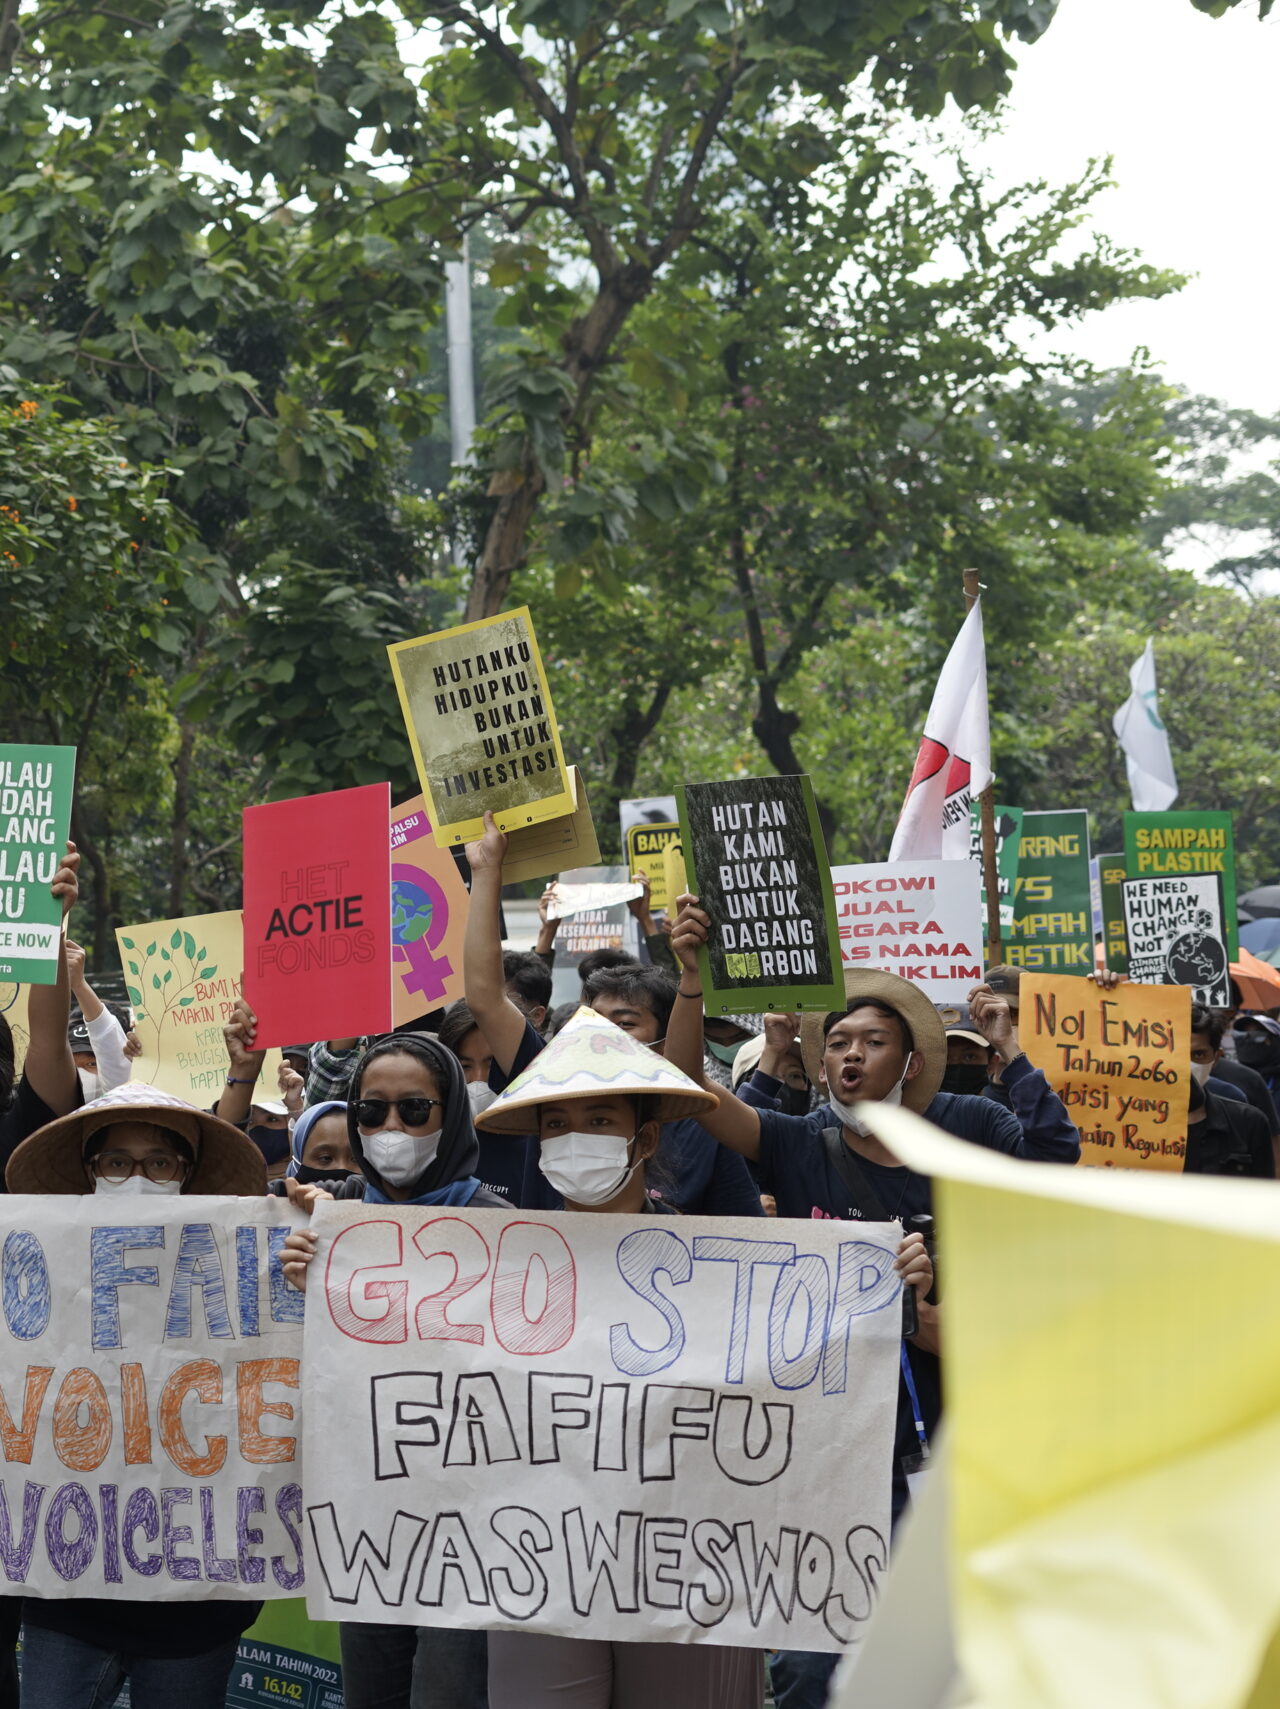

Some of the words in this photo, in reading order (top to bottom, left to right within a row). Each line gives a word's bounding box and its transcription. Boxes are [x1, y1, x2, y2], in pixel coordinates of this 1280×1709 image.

[432, 641, 531, 687] HUTANKU
[434, 670, 539, 715] HIDUPKU,
[473, 695, 544, 733] BUKAN
[482, 721, 551, 759] UNTUK
[444, 748, 556, 797] INVESTASI
[712, 800, 787, 832] HUTAN
[723, 830, 785, 861] KAMI
[1135, 828, 1226, 849] SAMPAH
[719, 860, 798, 891] BUKAN
[1137, 852, 1226, 872] PLASTIK
[281, 861, 350, 903] HET
[1126, 883, 1147, 898] WE
[1153, 882, 1188, 895] NEED
[265, 895, 363, 941] ACTIE
[726, 890, 801, 919] UNTUK
[838, 900, 915, 917] JUAL
[1129, 894, 1199, 919] HUMAN
[721, 919, 814, 949] DAGANG
[1132, 909, 1195, 937] CHANGE
[16, 933, 52, 948] NOW
[257, 929, 375, 978] FONDS
[879, 943, 972, 958] NAMA
[1134, 937, 1164, 953] NOT
[1128, 956, 1166, 969] CLIMATE
[1129, 964, 1167, 978] CHANGE
[194, 979, 229, 1001] BUMI
[172, 1007, 215, 1027] MAKIN
[1056, 1043, 1123, 1077] Tahun
[1127, 1055, 1178, 1085] 2060
[1122, 1123, 1186, 1160] Regulasi
[325, 1217, 577, 1355] G20
[610, 1228, 902, 1396] STOP
[371, 1371, 794, 1485] FAFIFU
[275, 1653, 313, 1676] TAHUN
[313, 1666, 337, 1684] 2022
[263, 1676, 302, 1700] 16.142
